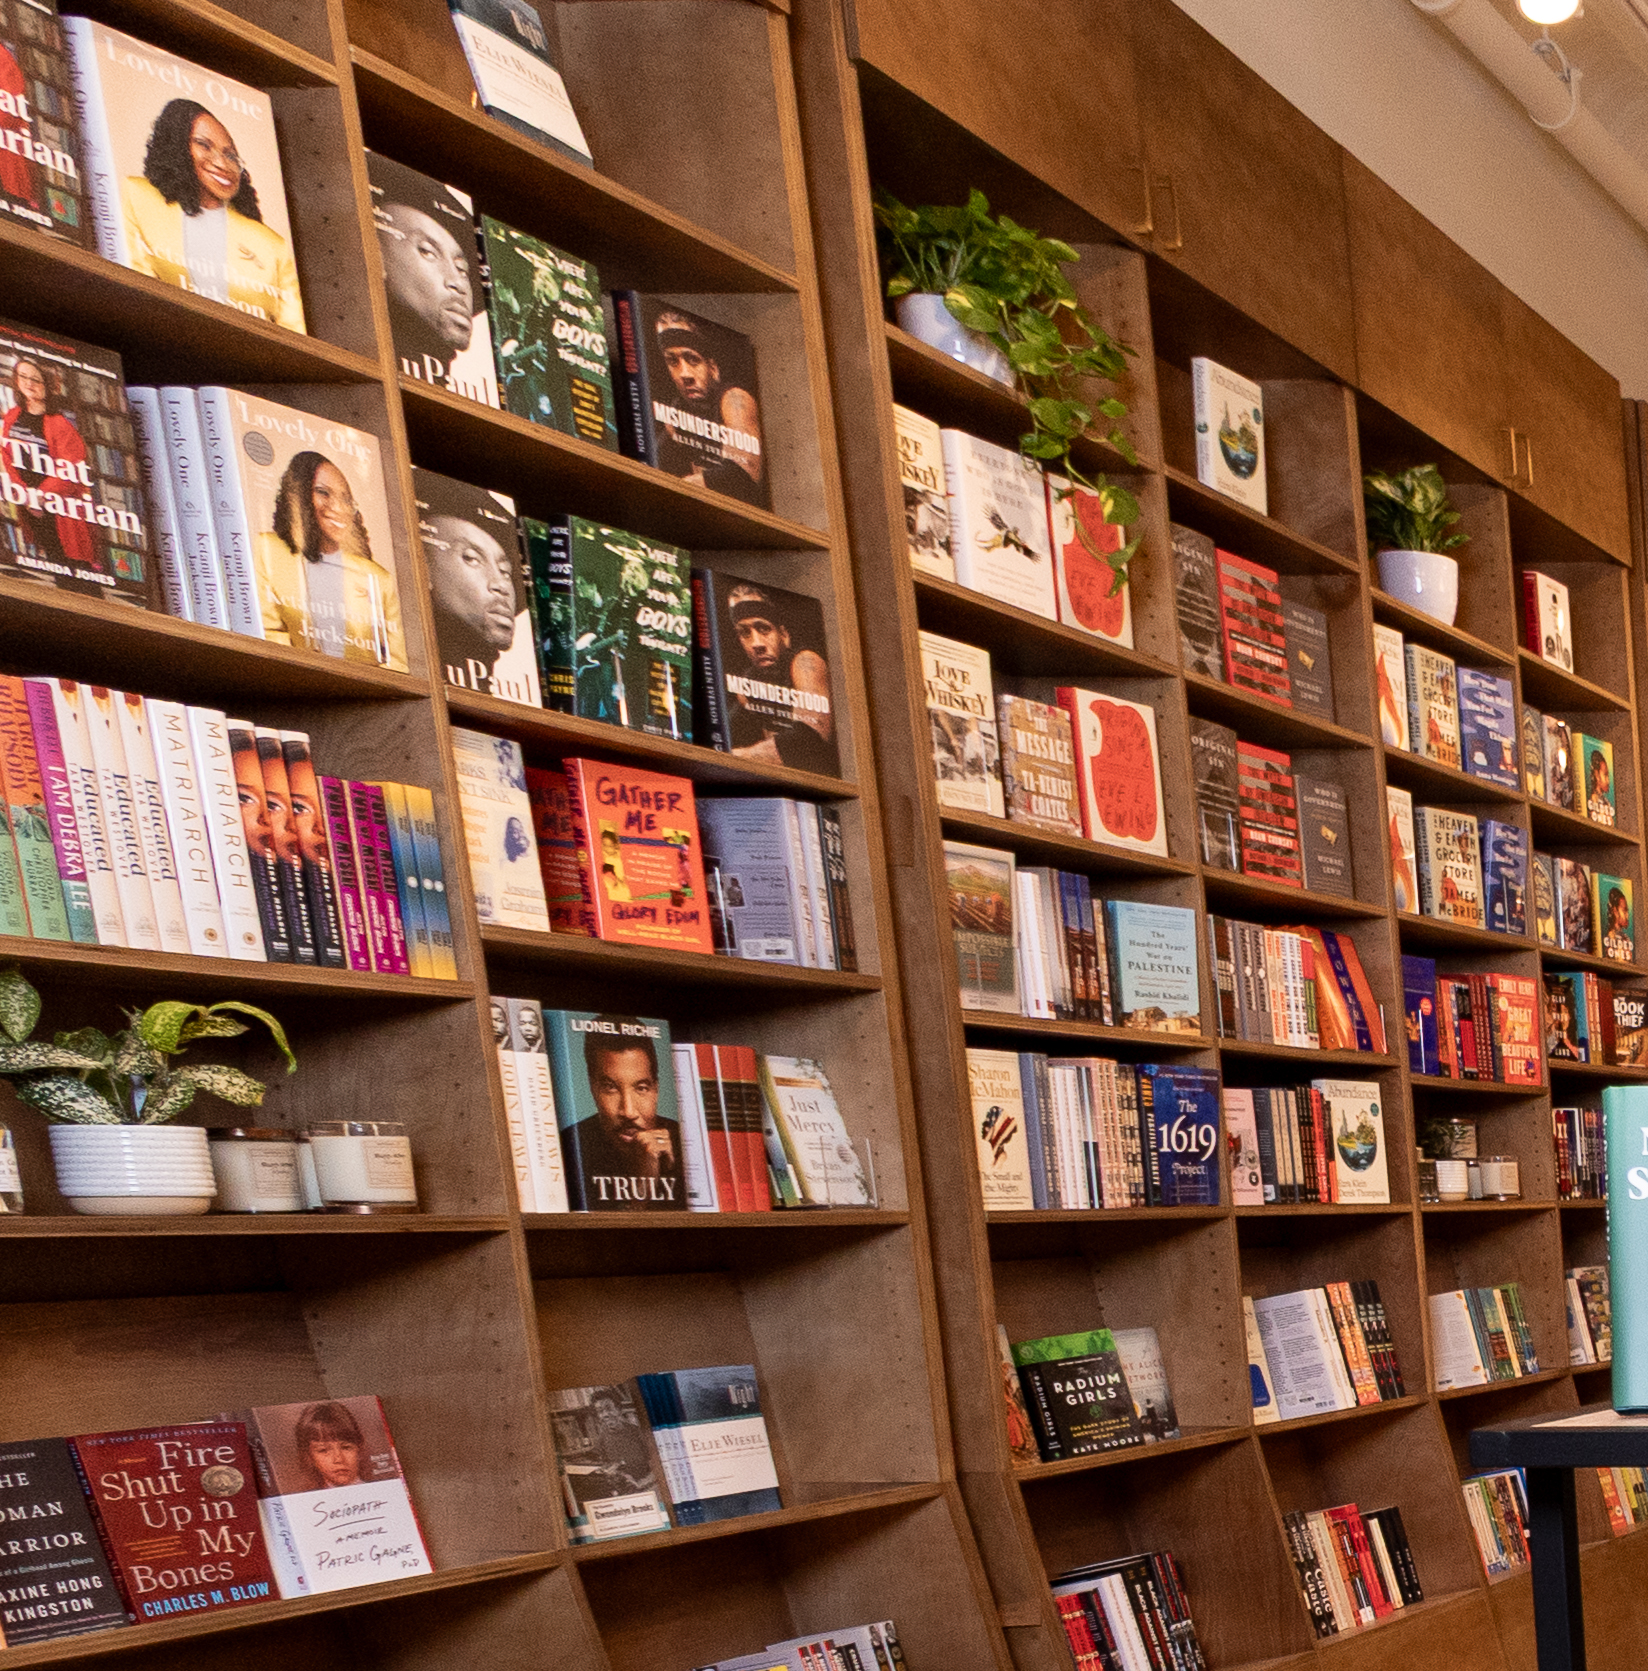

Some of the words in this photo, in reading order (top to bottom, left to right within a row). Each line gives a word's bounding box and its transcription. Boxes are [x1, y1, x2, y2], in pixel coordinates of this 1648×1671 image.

[103, 36, 196, 97] Lovely
[205, 80, 263, 121] One
[238, 400, 320, 447] Lovely
[652, 401, 760, 456] MISUNDERSTOOD
[203, 400, 220, 453] Lovely
[213, 455, 225, 488] One
[2, 437, 94, 488] That
[16, 556, 72, 577] AMANDA
[75, 568, 117, 587] JONES
[636, 605, 692, 638] BOYS
[933, 661, 971, 686] LOVE
[726, 673, 829, 714] MISUNDERSTOOD
[1015, 730, 1073, 764] MESSAGE
[50, 778, 71, 807] AM
[205, 721, 247, 889] MATRIARCH
[595, 777, 684, 813] GATHER
[81, 766, 112, 871] Educated
[145, 778, 176, 880] Educated
[624, 811, 658, 832] ME
[57, 811, 84, 877] DEBRA
[68, 882, 90, 910] LEE
[611, 902, 657, 925] GLORY
[666, 907, 700, 927] EDIM
[1127, 959, 1193, 976] PALESTINE
[1614, 999, 1645, 1016] BOOK
[1614, 1013, 1644, 1028] THIEF
[571, 1018, 619, 1036] LIONEL
[621, 1022, 661, 1038] RICHIE
[788, 1095, 822, 1114] Just
[1178, 1100, 1198, 1114] The
[787, 1113, 836, 1137] Mercy
[1159, 1114, 1217, 1162] 1619
[593, 1175, 676, 1200] TRULY
[1053, 1371, 1121, 1394] RADIUM
[1066, 1386, 1117, 1406] GIRLS
[155, 1440, 236, 1470] Fire
[690, 1436, 722, 1453] ELIE
[723, 1432, 764, 1447] WIESEL
[1073, 1443, 1099, 1454] KATE
[1103, 1435, 1141, 1449] MOORE
[101, 1471, 186, 1500] Shut
[139, 1503, 192, 1532] Up
[202, 1497, 237, 1520] in
[199, 1528, 255, 1557] My
[56, 1575, 103, 1591] HONG
[130, 1561, 235, 1594] Bones
[5, 1597, 94, 1624] KINGSTON
[143, 1593, 208, 1617] CHARLES
[231, 1581, 270, 1601] BLOW
